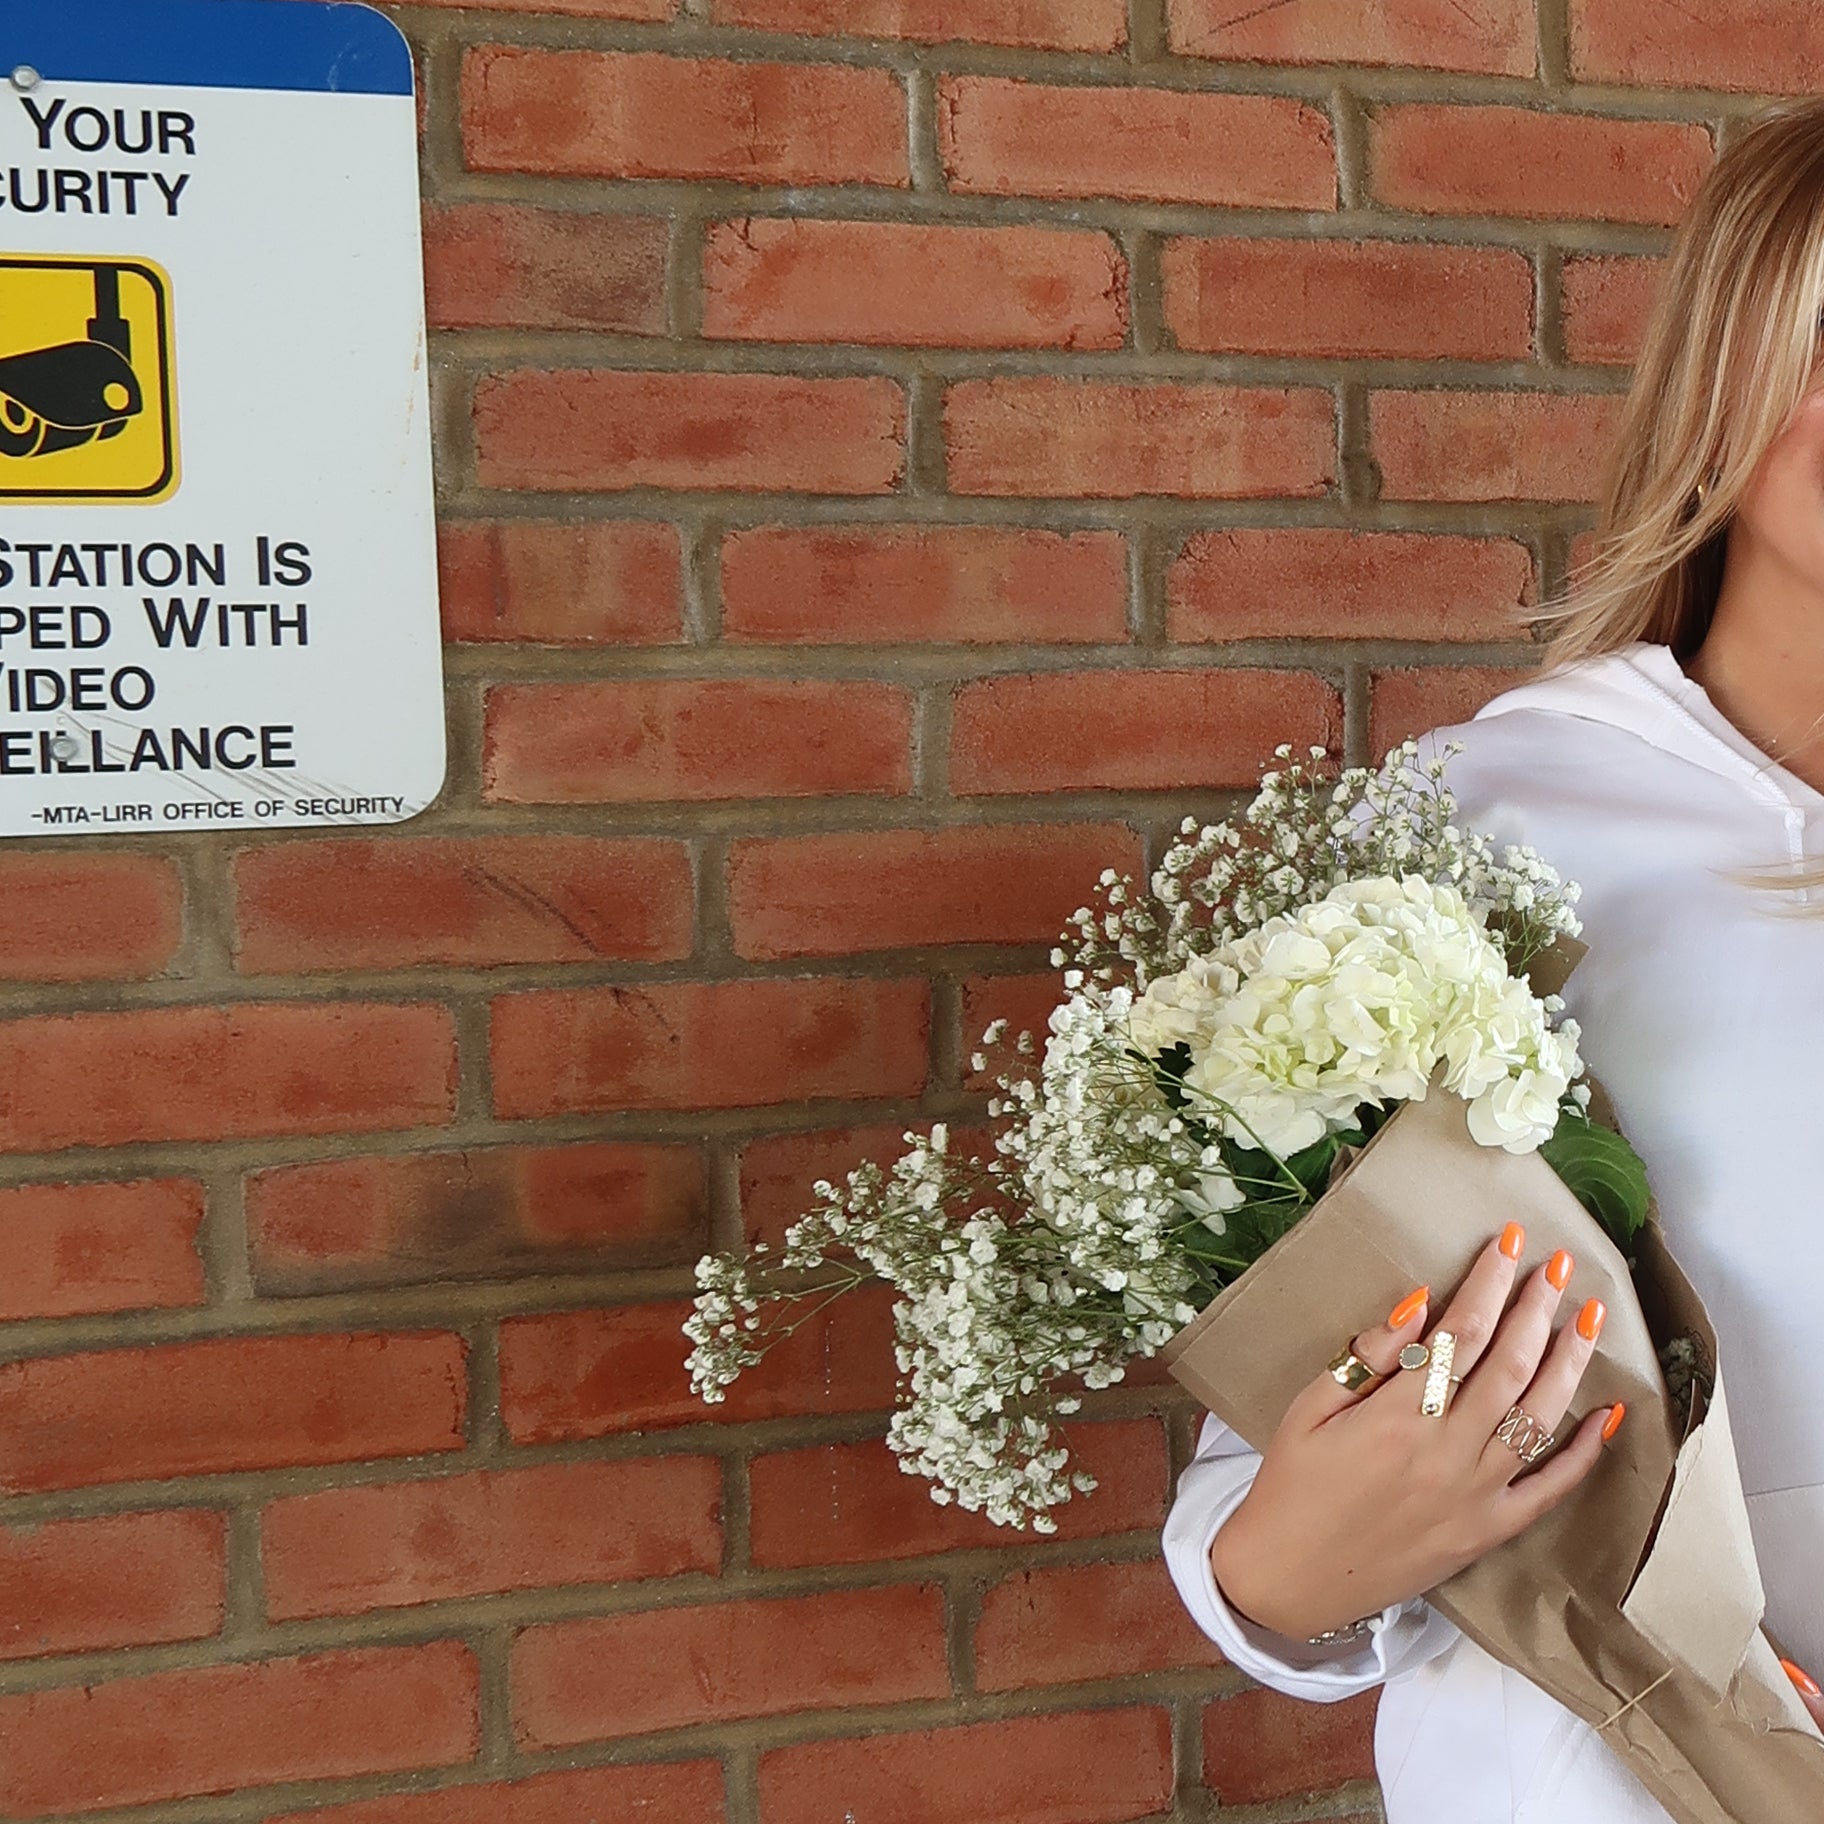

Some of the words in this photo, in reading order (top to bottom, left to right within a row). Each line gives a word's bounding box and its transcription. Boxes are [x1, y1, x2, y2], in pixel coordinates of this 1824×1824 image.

[19, 96, 196, 155] YOUR
[0, 167, 191, 217] URITY
[0, 661, 155, 712] IDEO
[31, 804, 153, 824] -MTA-LIRR
[163, 801, 244, 821] OFFICE
[254, 799, 285, 818] OF
[294, 796, 404, 816] SECURITY
